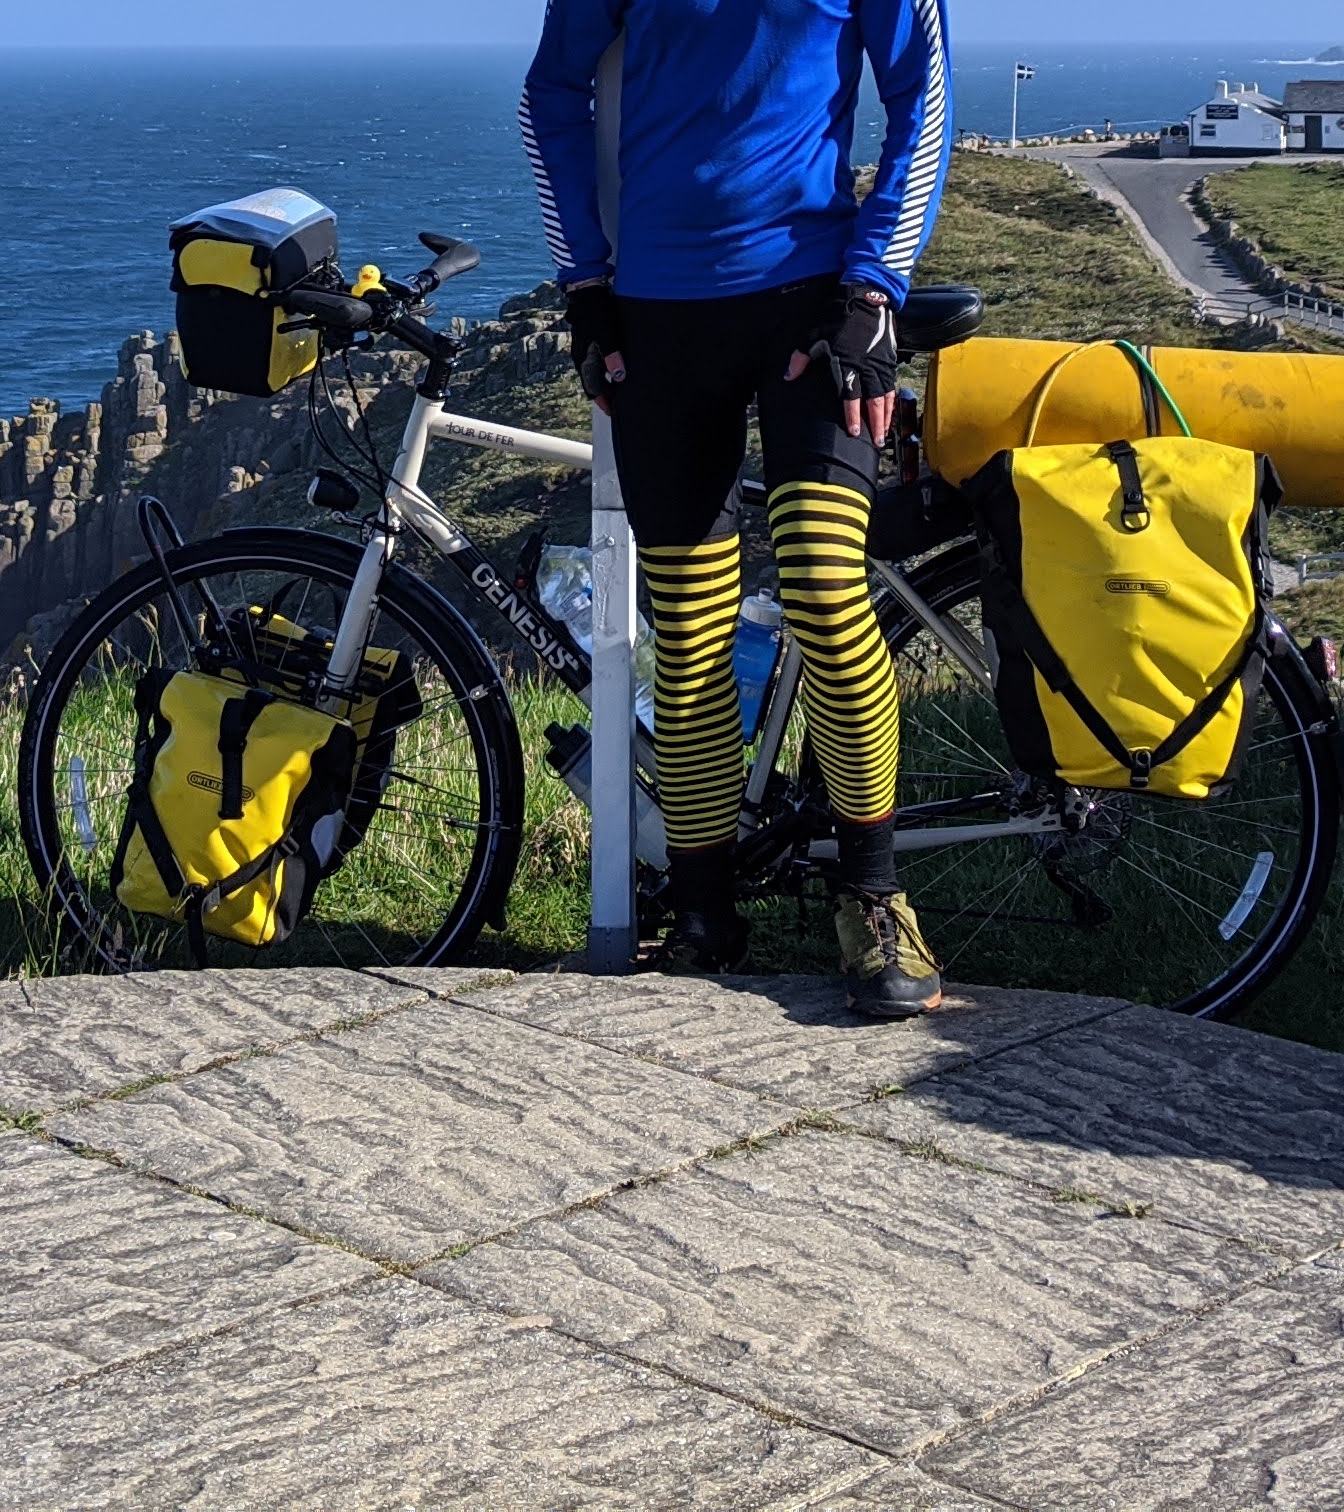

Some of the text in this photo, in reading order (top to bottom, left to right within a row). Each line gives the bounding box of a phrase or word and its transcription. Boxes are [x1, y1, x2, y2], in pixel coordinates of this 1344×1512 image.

[478, 430, 493, 442] DE
[496, 434, 514, 447] FER
[471, 562, 566, 670] GENESIS
